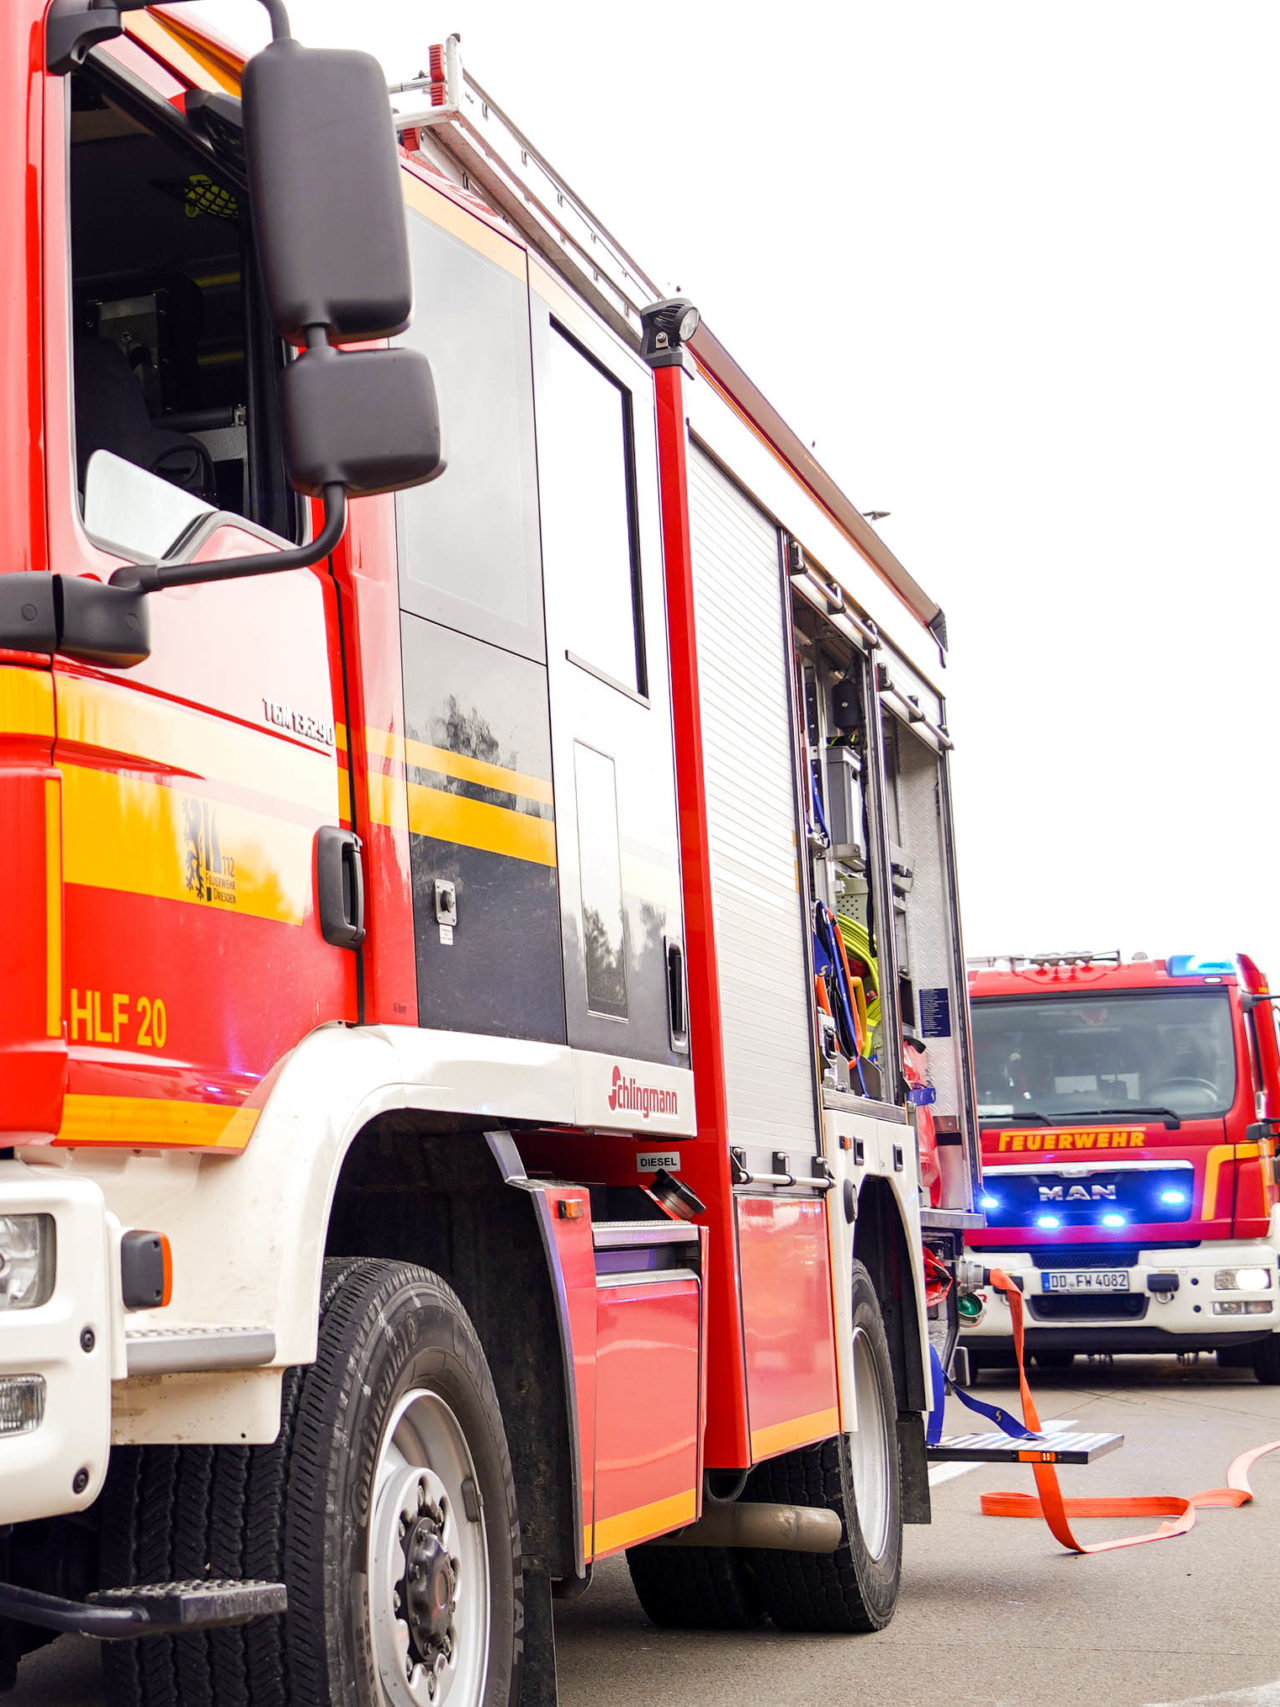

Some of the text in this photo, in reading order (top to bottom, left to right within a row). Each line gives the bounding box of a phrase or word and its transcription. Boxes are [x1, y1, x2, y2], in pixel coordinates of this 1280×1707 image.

[71, 988, 167, 1049] HLF 20
[608, 1065, 678, 1118] Schlingmann
[999, 1127, 1146, 1151] FEUERWEHR
[640, 1158, 677, 1167] DIESEL
[1038, 1185, 1117, 1201] MAN
[1051, 1276, 1066, 1288] DD
[1076, 1275, 1092, 1287] FW
[1096, 1274, 1126, 1287] 4082
